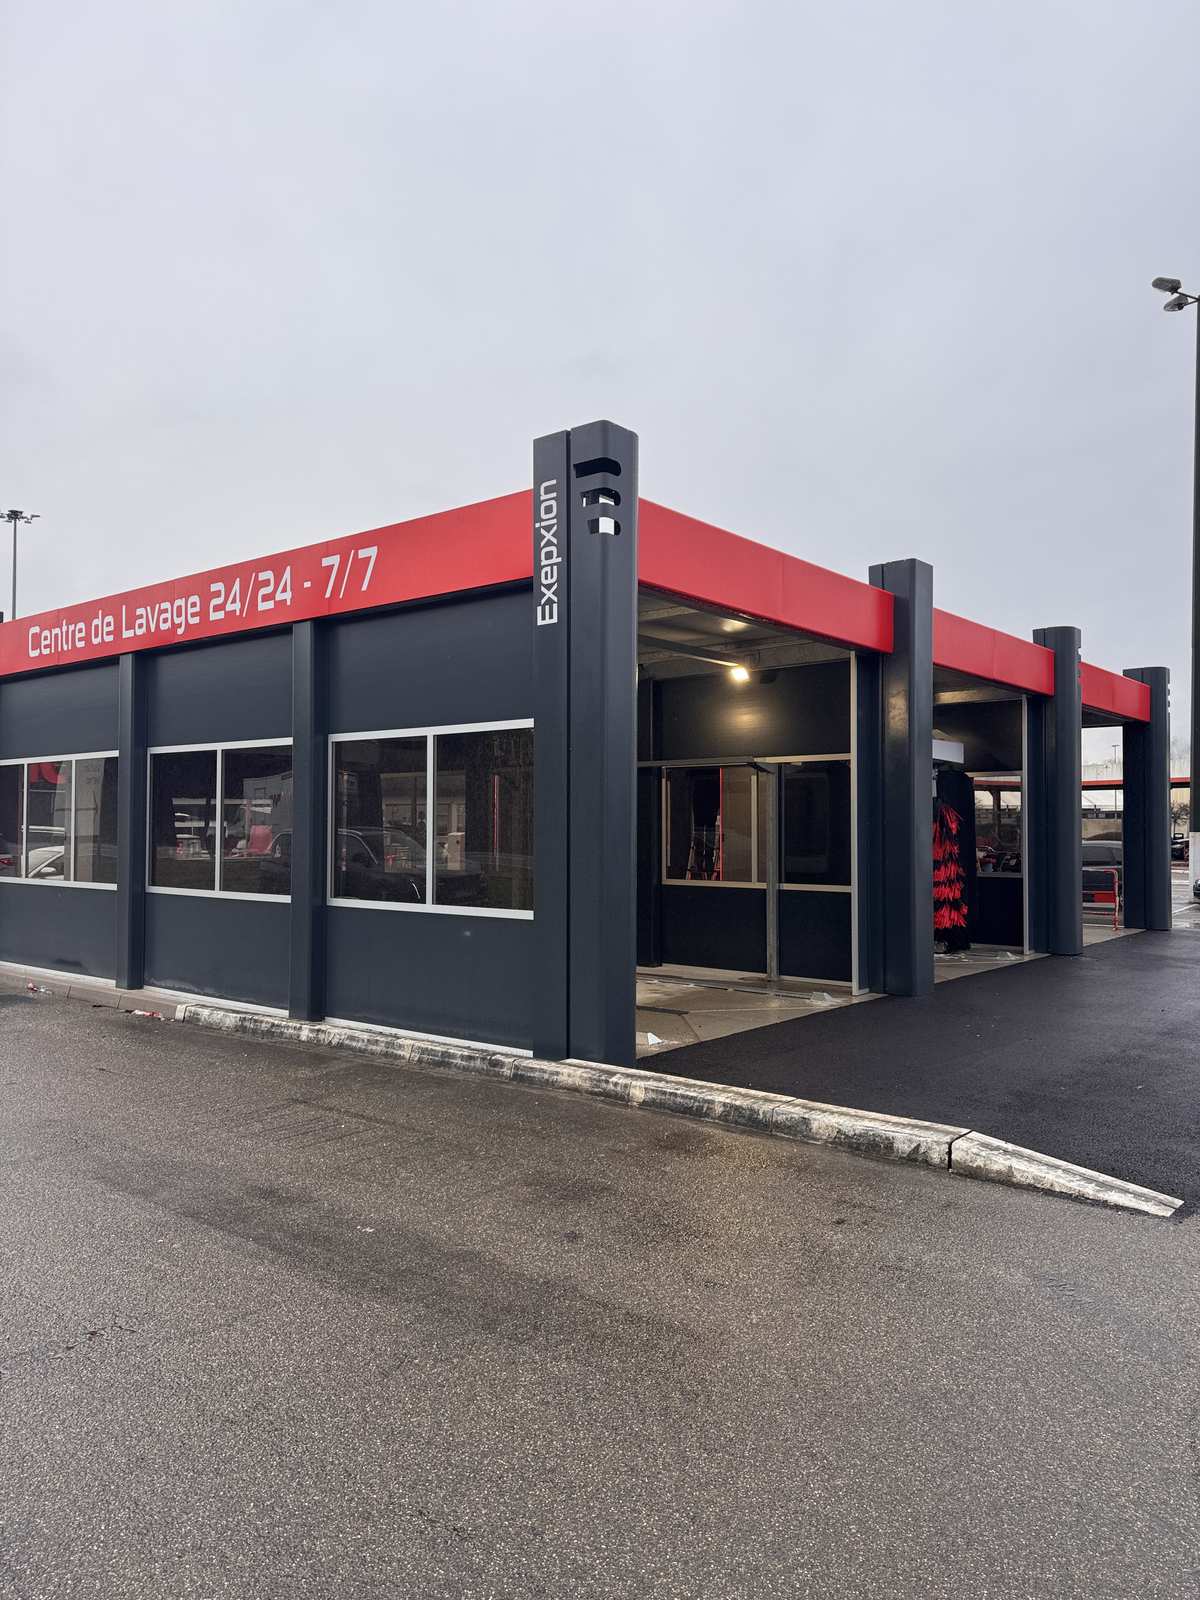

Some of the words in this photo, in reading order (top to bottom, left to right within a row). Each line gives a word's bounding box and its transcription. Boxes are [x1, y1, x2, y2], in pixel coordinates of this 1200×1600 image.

[28, 625, 85, 658] Centre
[91, 610, 114, 644] de
[121, 594, 200, 638] Lavage
[209, 565, 292, 621] 24/24
[321, 545, 378, 599] 7/7
[535, 479, 562, 626] Exepxion
